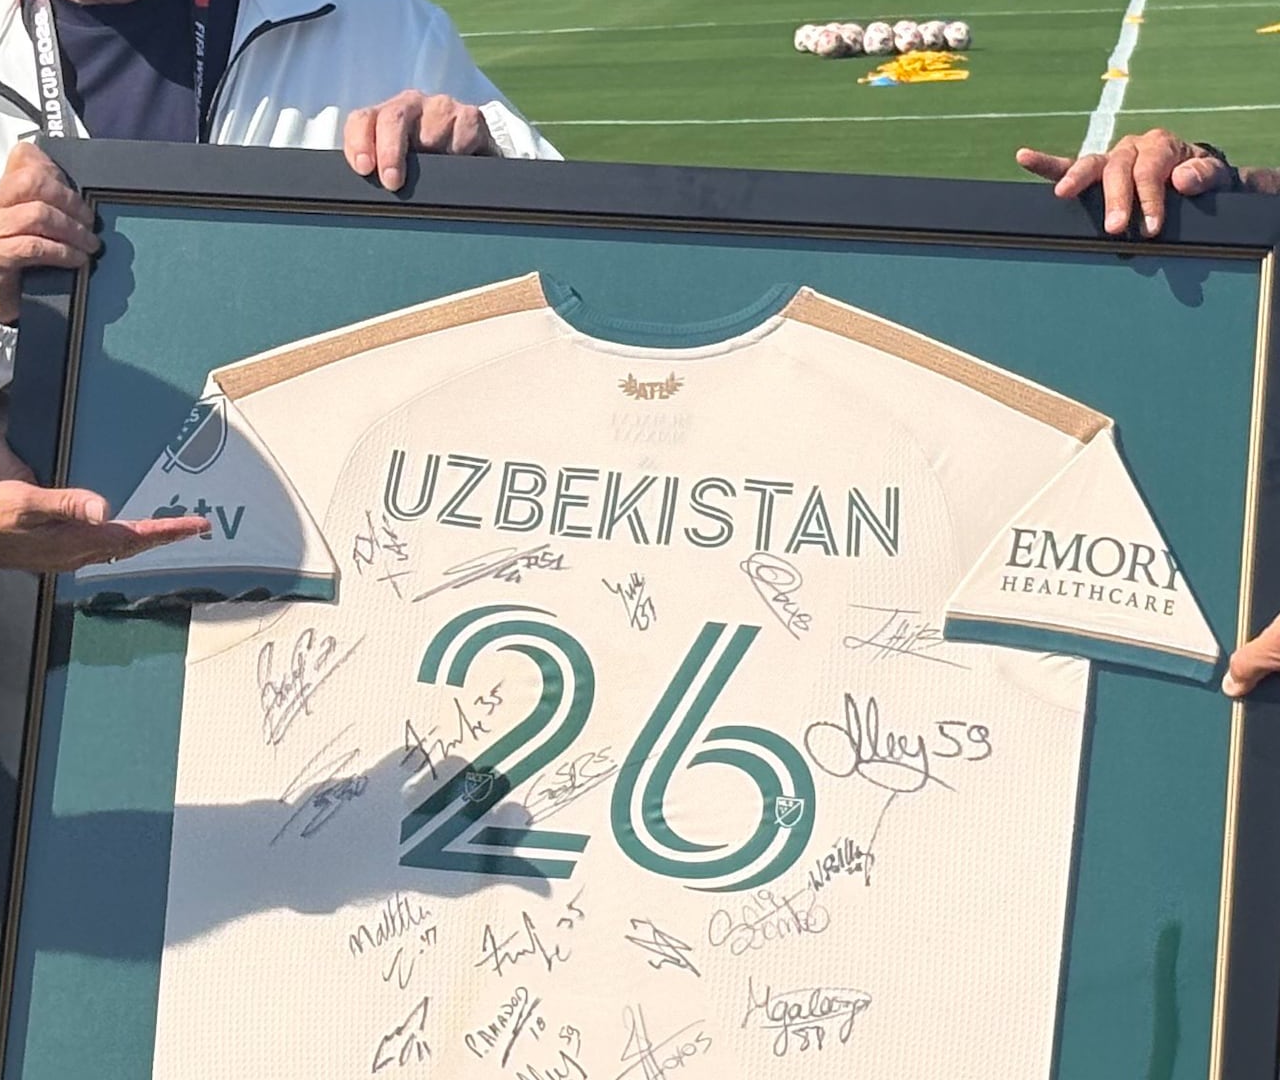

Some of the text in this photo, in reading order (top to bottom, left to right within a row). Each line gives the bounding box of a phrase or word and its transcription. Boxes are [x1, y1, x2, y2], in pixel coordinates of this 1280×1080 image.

[41, 67, 58, 98] CUP
[382, 449, 901, 558] UZBEKISTAN
[1004, 526, 1179, 592] EMORY
[1000, 575, 1176, 617] HEALTHCARE
[398, 603, 818, 894] 26
